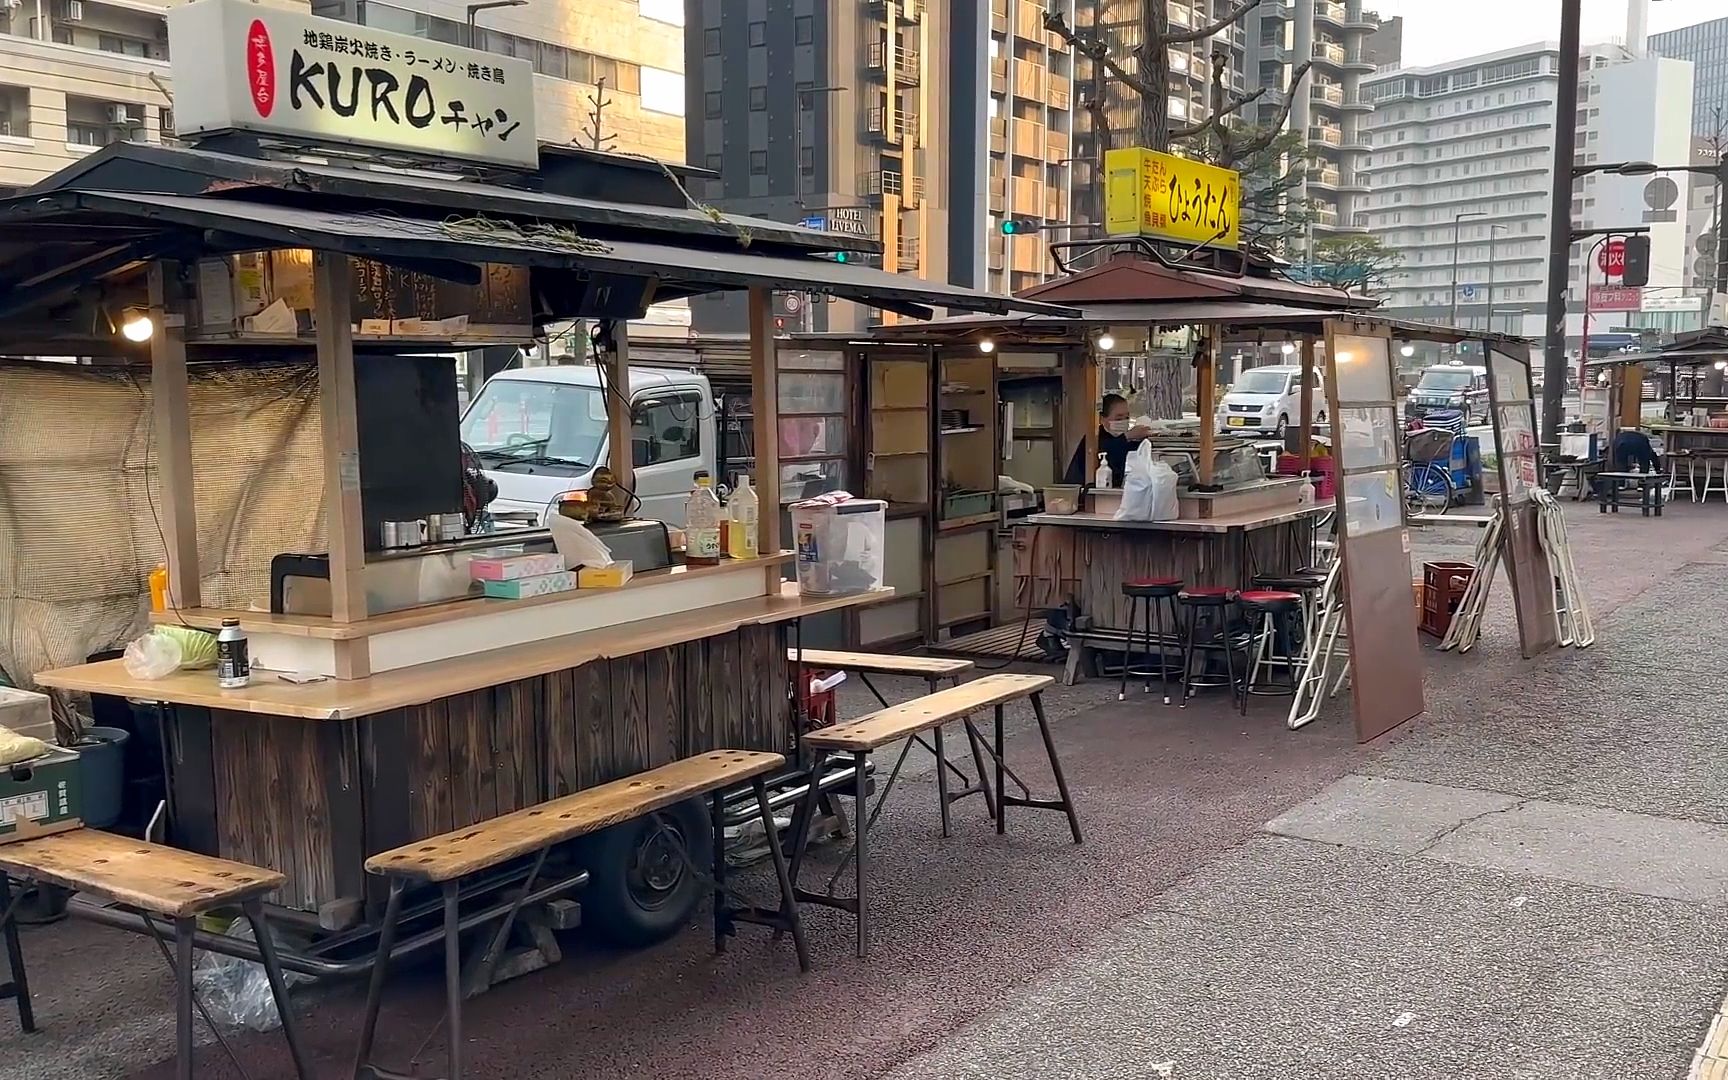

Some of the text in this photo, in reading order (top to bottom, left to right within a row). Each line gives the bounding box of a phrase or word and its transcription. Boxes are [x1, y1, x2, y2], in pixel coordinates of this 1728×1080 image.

[303, 28, 505, 85] 地鶏炭火焼き・ラーメン・焼き鳥
[1143, 157, 1167, 176] 牛たん
[1143, 175, 1167, 194] 天ぷら
[1169, 174, 1231, 233] ひょうたん
[836, 208, 863, 221] HOTEL
[787, 299, 797, 308] 50
